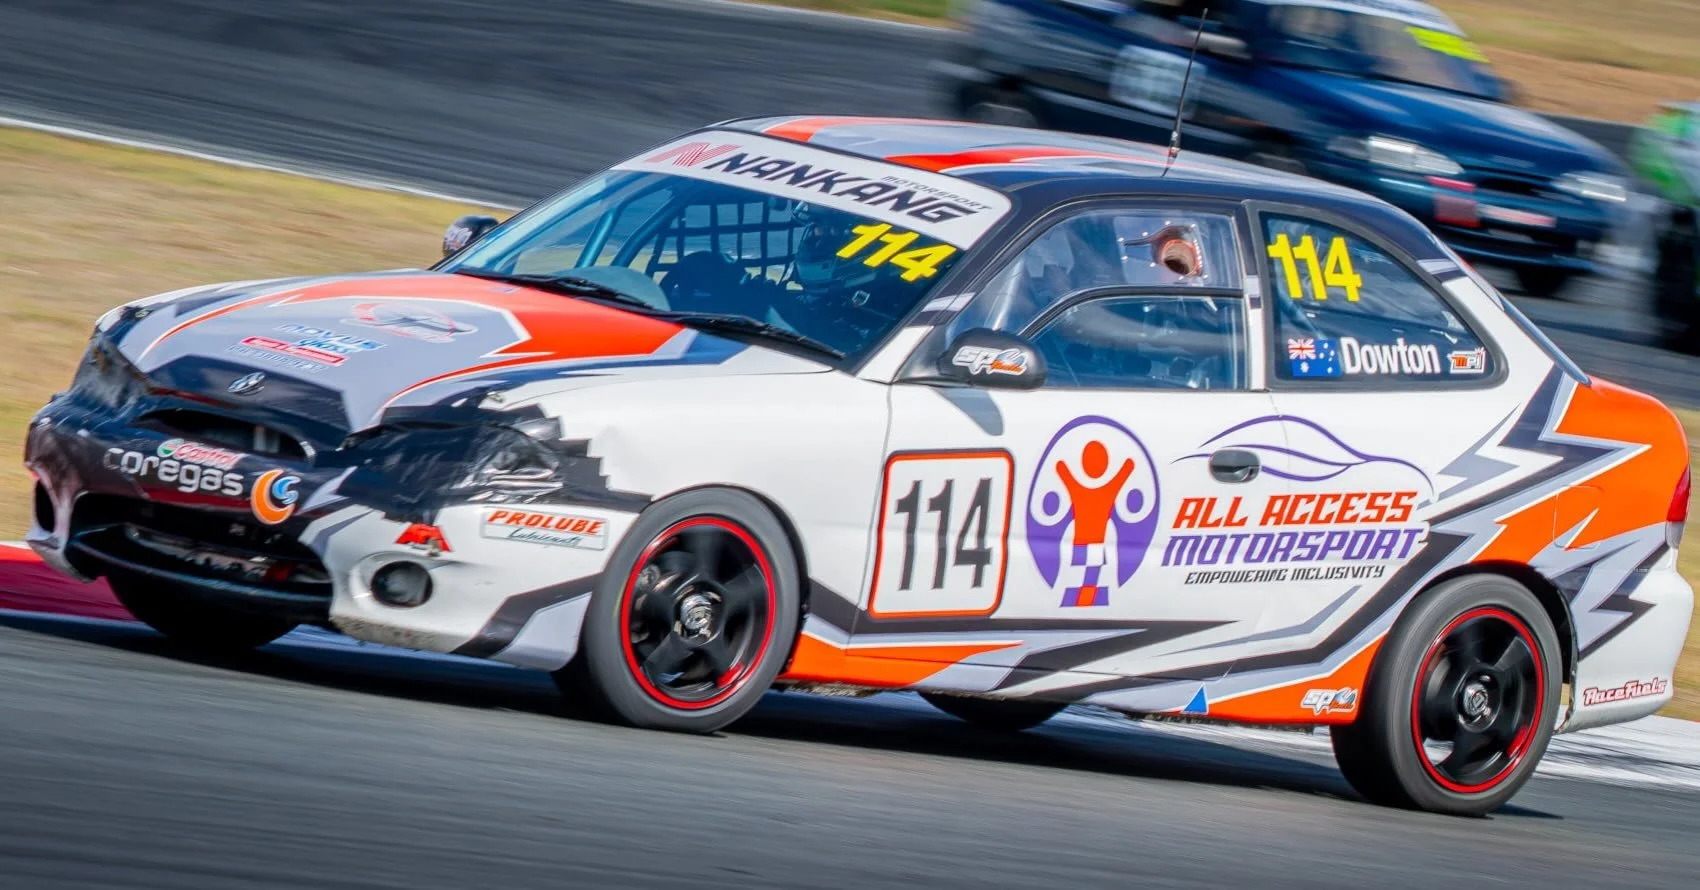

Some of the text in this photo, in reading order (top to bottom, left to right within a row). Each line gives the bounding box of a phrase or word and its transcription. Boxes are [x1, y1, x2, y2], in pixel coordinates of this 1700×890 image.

[703, 153, 978, 224] NANKANG
[882, 175, 992, 210] MOTORSPORT
[836, 223, 957, 282] 114
[1267, 234, 1362, 302] 114
[1340, 337, 1441, 375] Dowton
[103, 447, 245, 496] coregas
[487, 510, 605, 536] PROLUBE
[1172, 491, 1418, 529] ALL ACCESS
[894, 477, 993, 591] 114
[1161, 528, 1424, 567] MOTORSPORT
[1184, 565, 1385, 585] EMPOWERING INCLUSIVITY
[1583, 676, 1668, 706] RaceFuels
